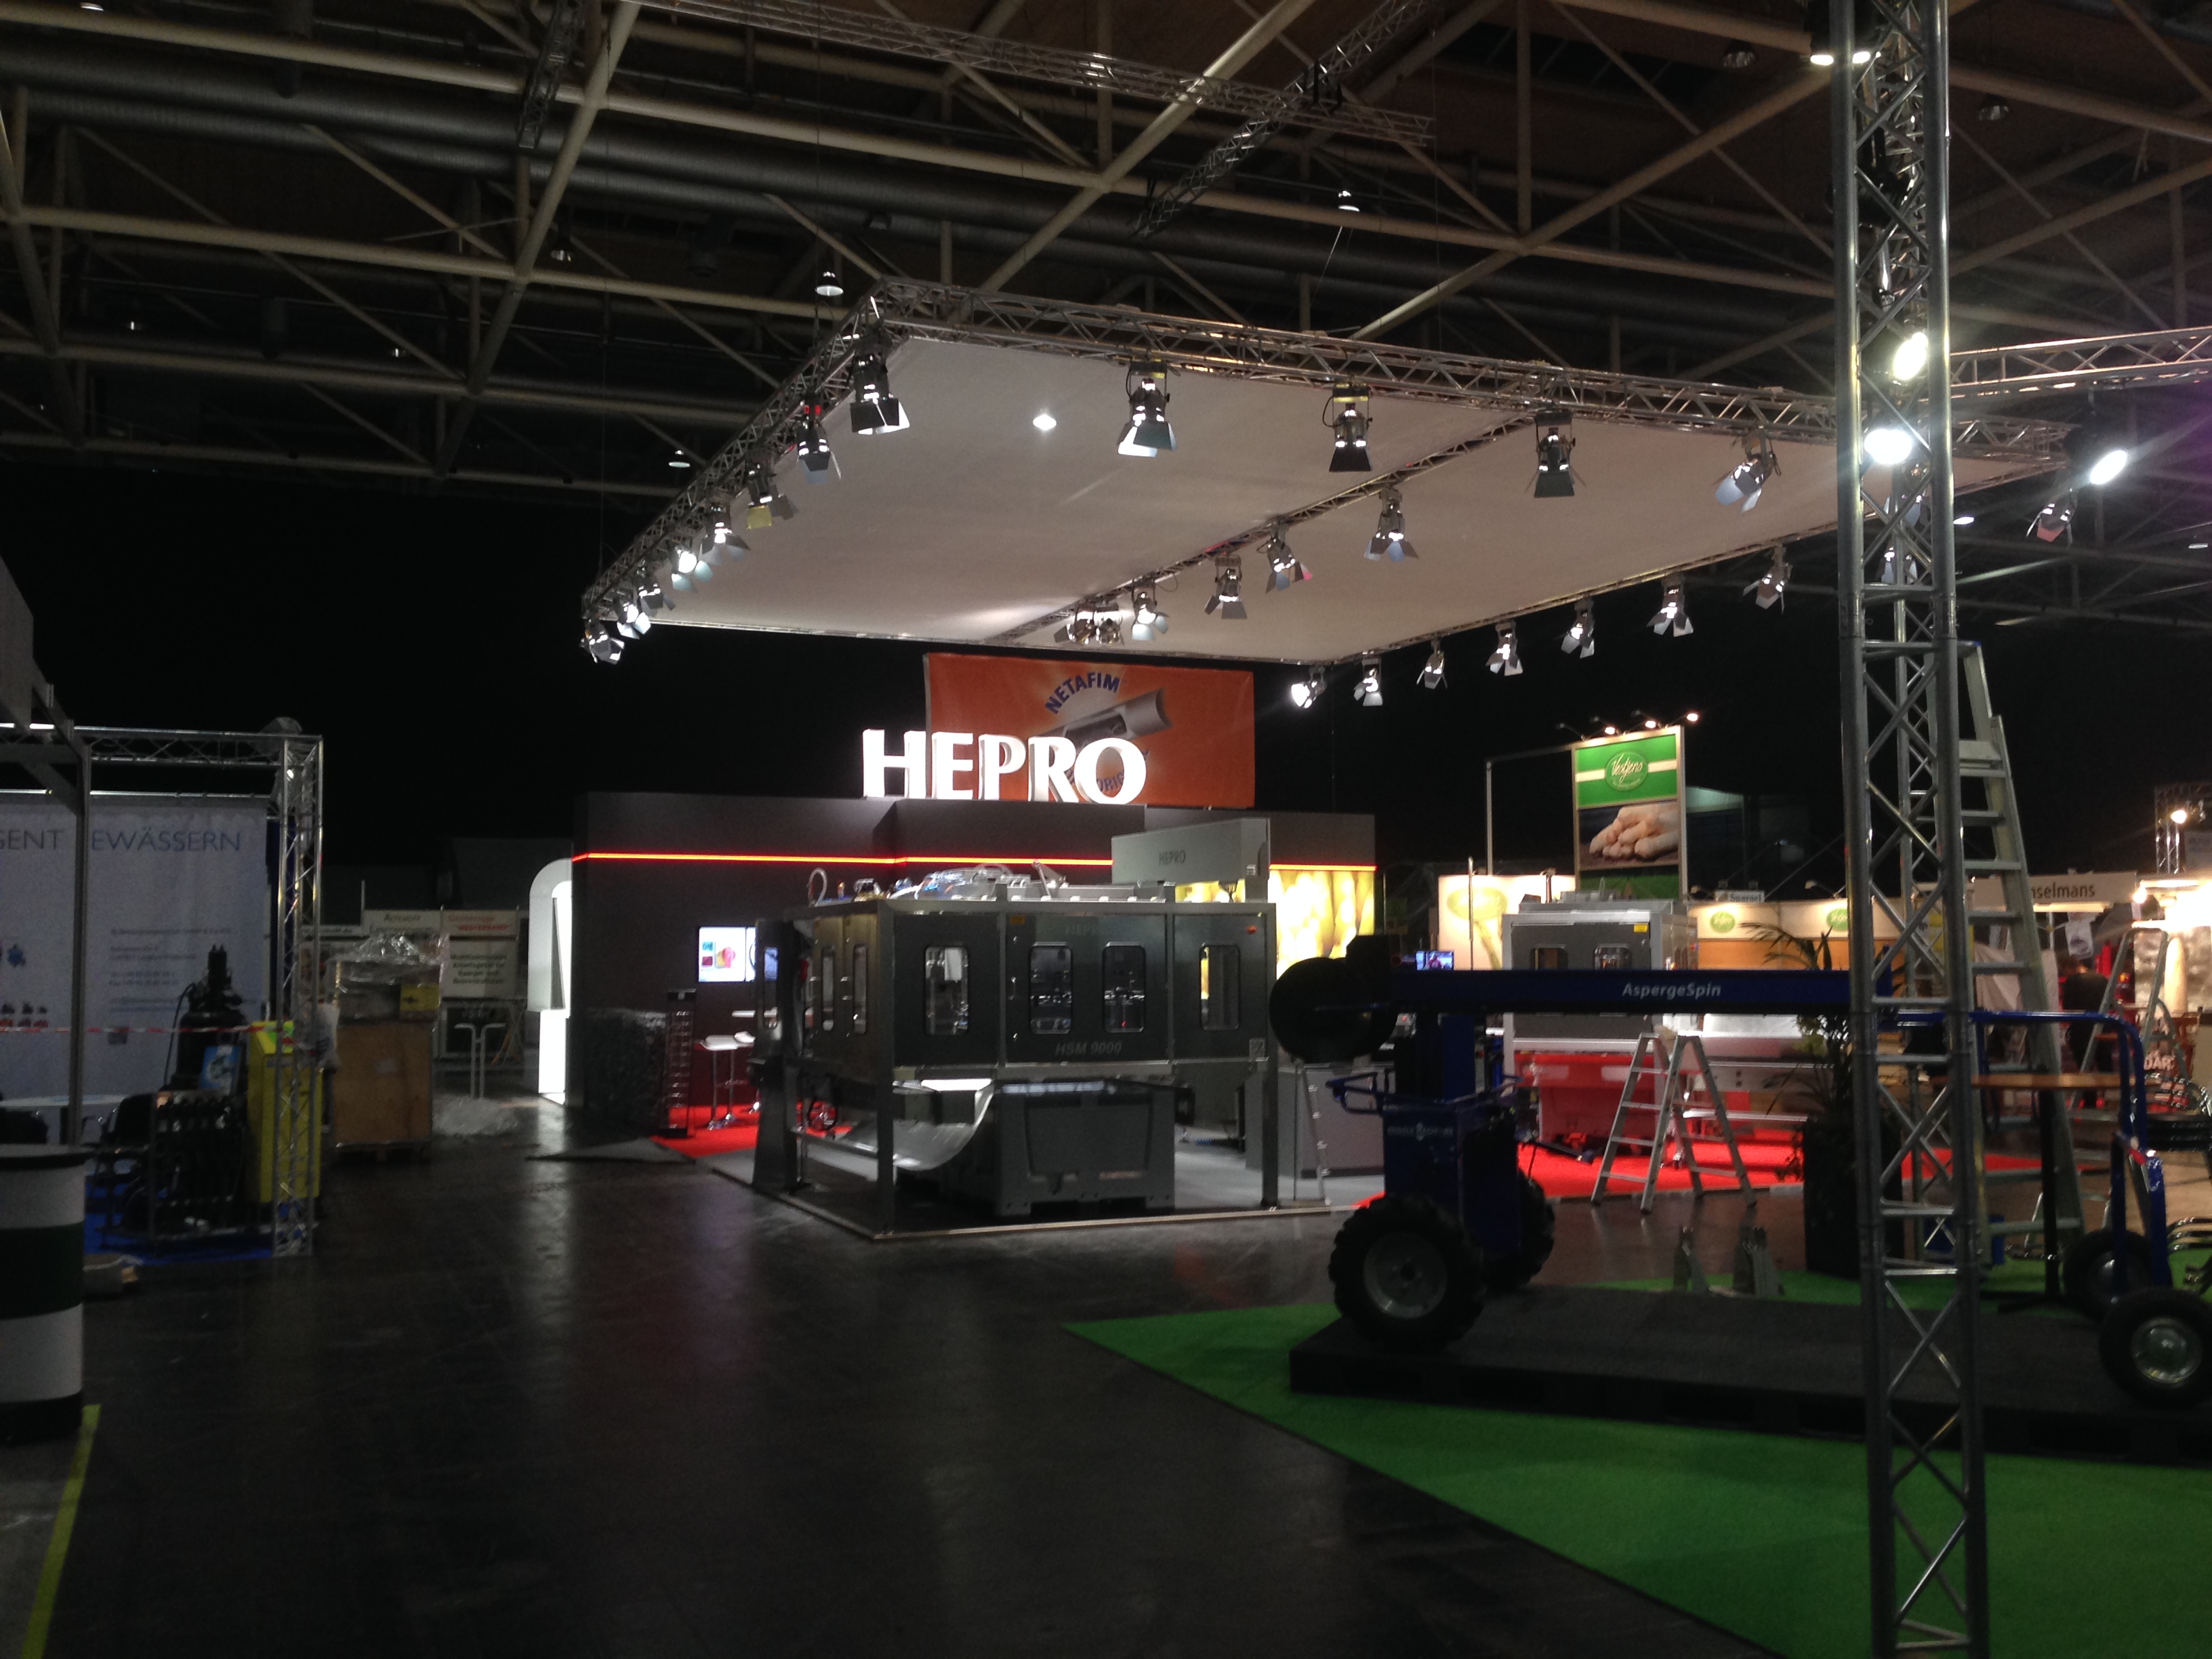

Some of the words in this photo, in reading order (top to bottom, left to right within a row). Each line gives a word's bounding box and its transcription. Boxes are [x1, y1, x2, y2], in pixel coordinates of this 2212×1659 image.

[1044, 672, 1121, 715] NETAFIM
[863, 729, 1147, 805] HEPRO
[0, 829, 65, 851] ENT
[91, 827, 241, 852] EWÄSSERN
[1158, 849, 1187, 865] HEPRO
[1622, 981, 1722, 1000] AspergeSpin
[1054, 1040, 1088, 1057] HSM
[1090, 1040, 1123, 1055] 9000
